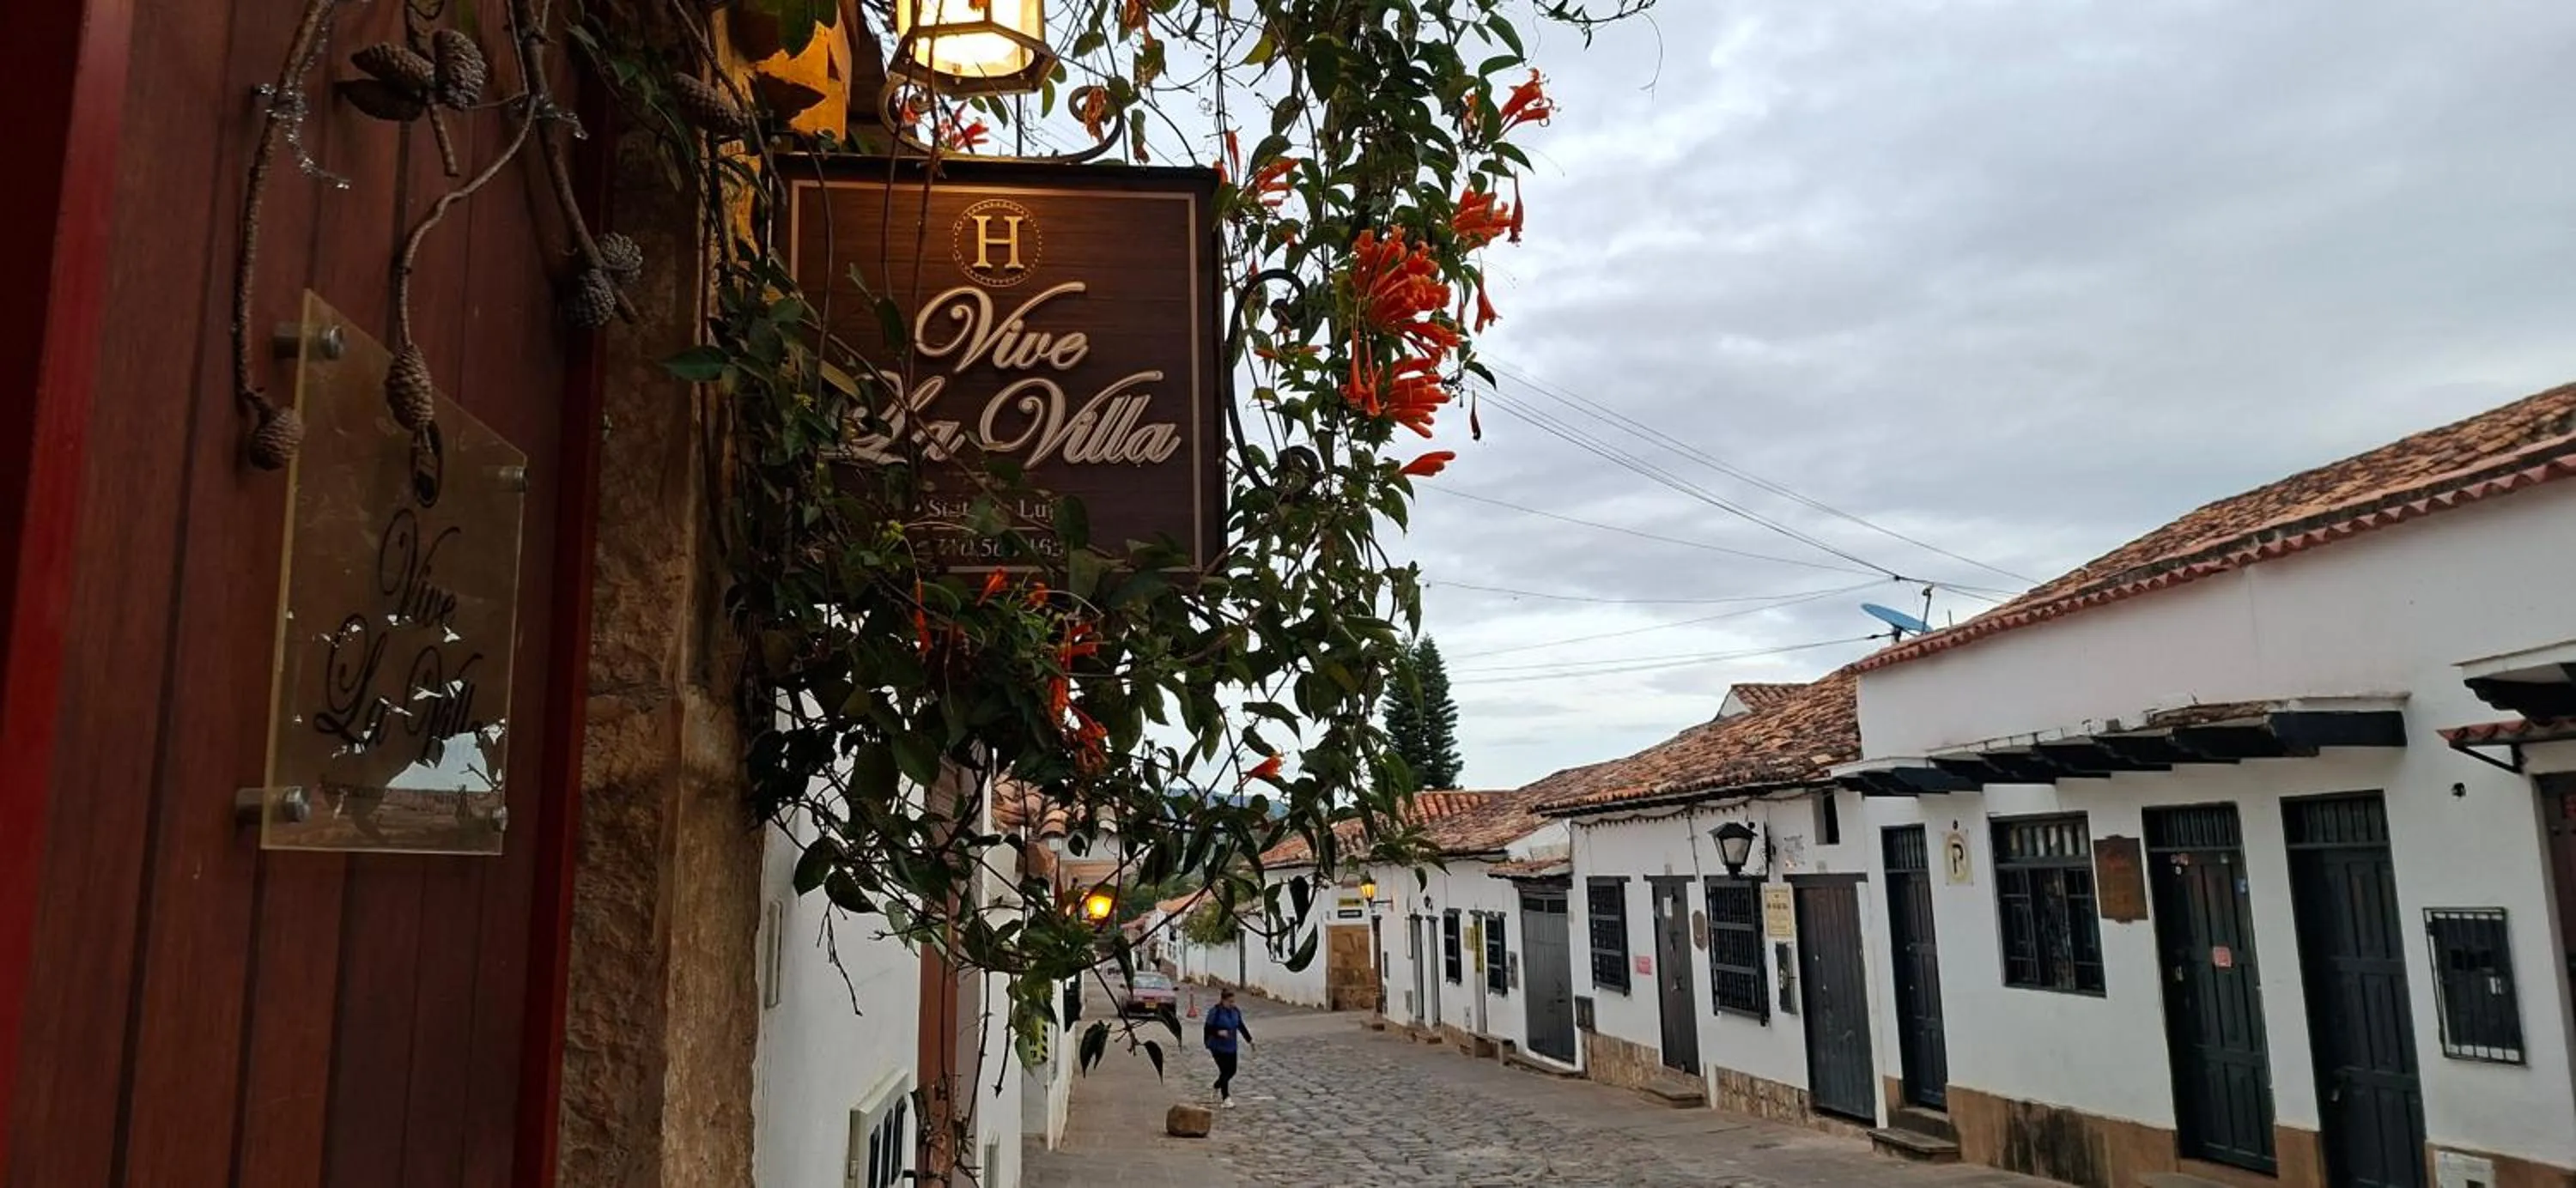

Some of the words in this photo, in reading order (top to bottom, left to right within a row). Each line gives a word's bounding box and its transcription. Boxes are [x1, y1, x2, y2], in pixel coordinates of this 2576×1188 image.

[972, 215, 1025, 270] H
[914, 281, 1089, 373] Vive
[979, 370, 1182, 469] Villa
[379, 507, 461, 627] Vive
